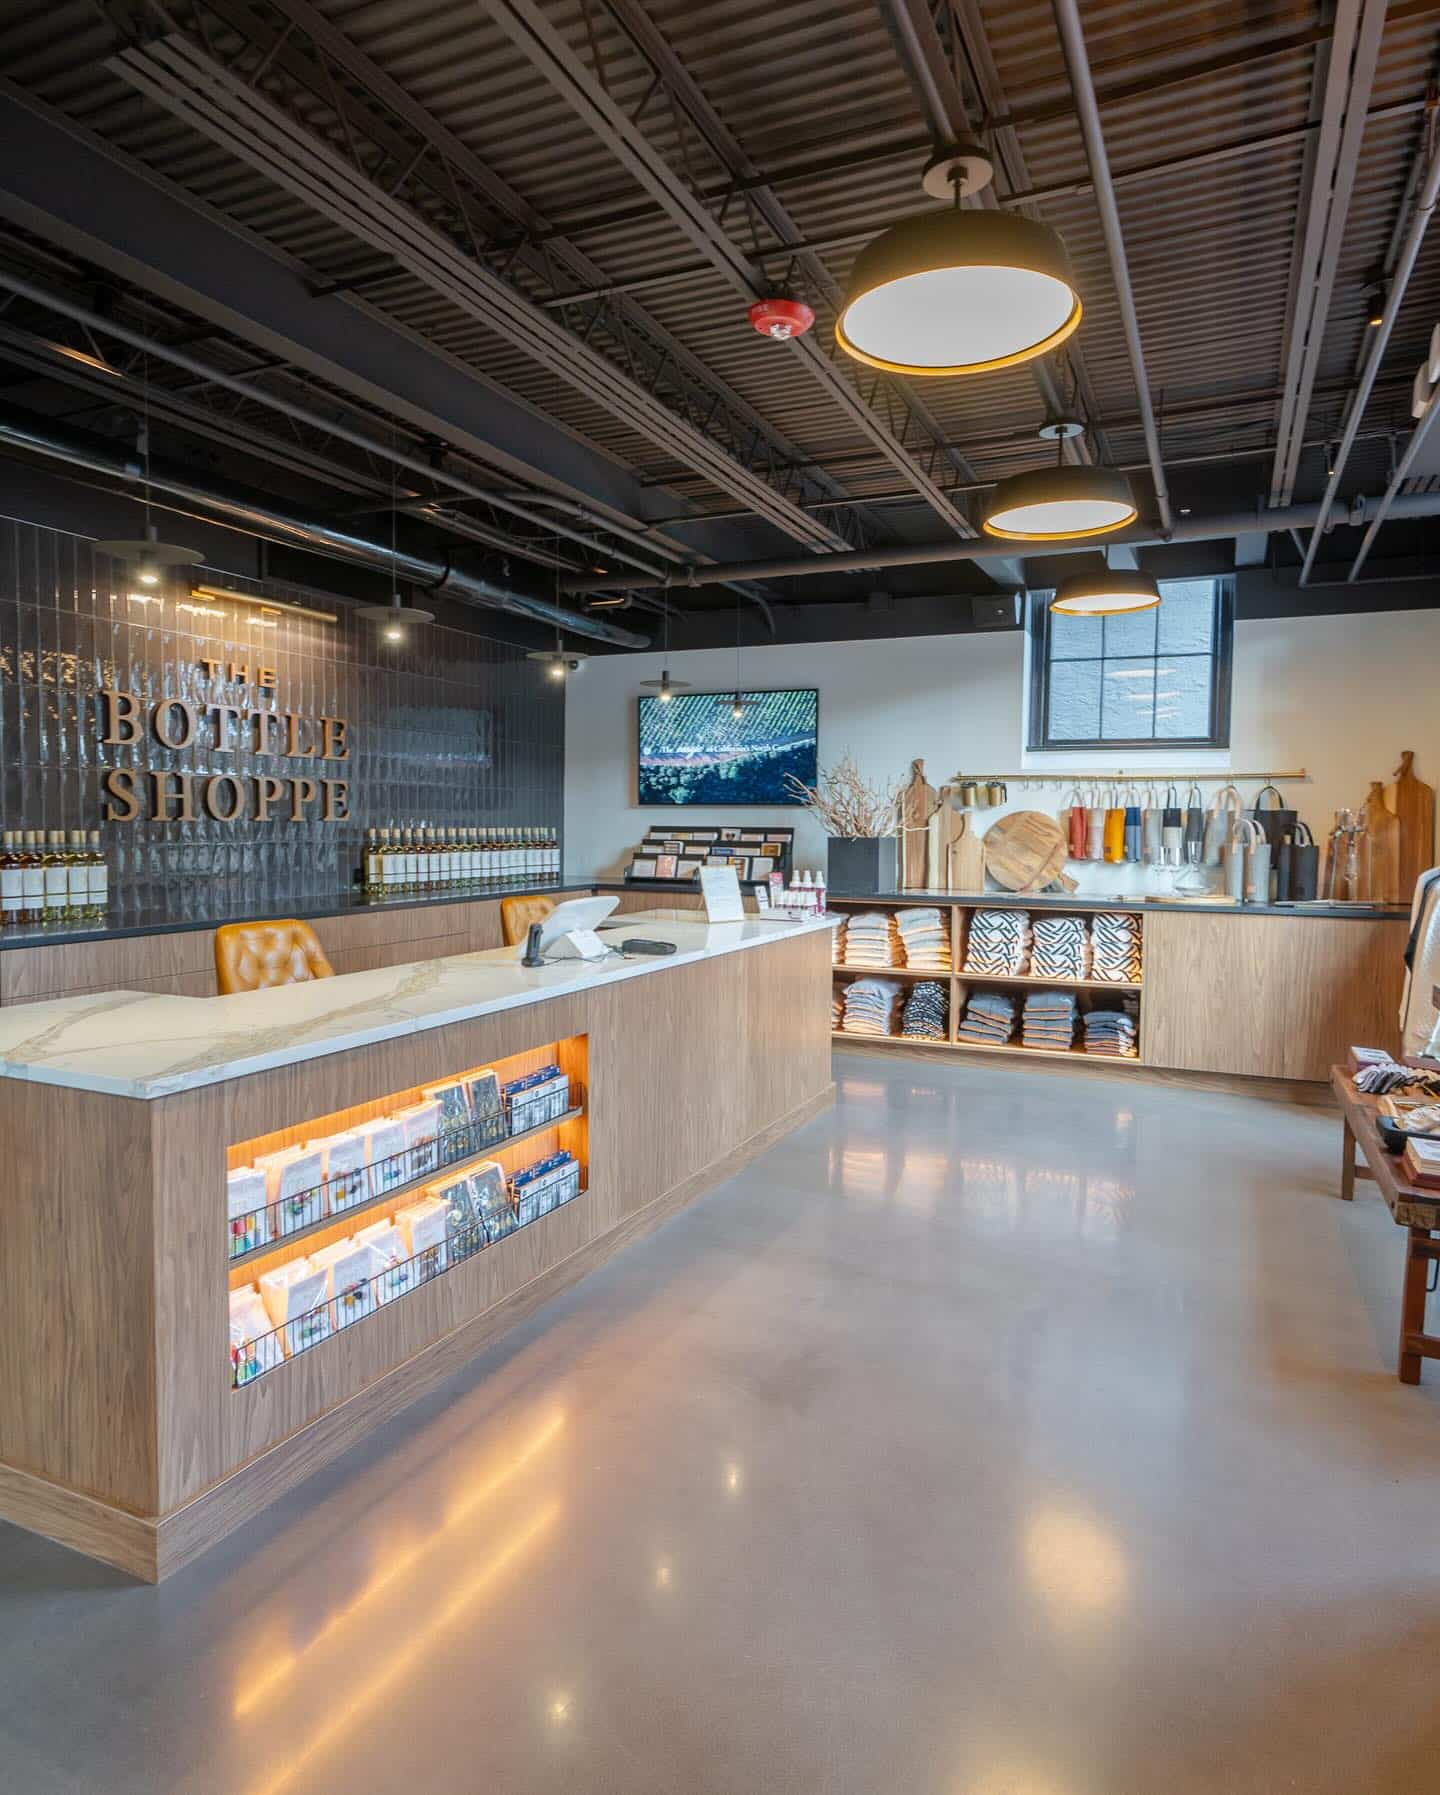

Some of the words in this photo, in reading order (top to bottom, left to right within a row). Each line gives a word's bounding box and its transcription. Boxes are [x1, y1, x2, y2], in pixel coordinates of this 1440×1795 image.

[202, 659, 276, 688] THE
[102, 690, 350, 760] BOTTLE
[106, 768, 349, 822] SHOPPE
